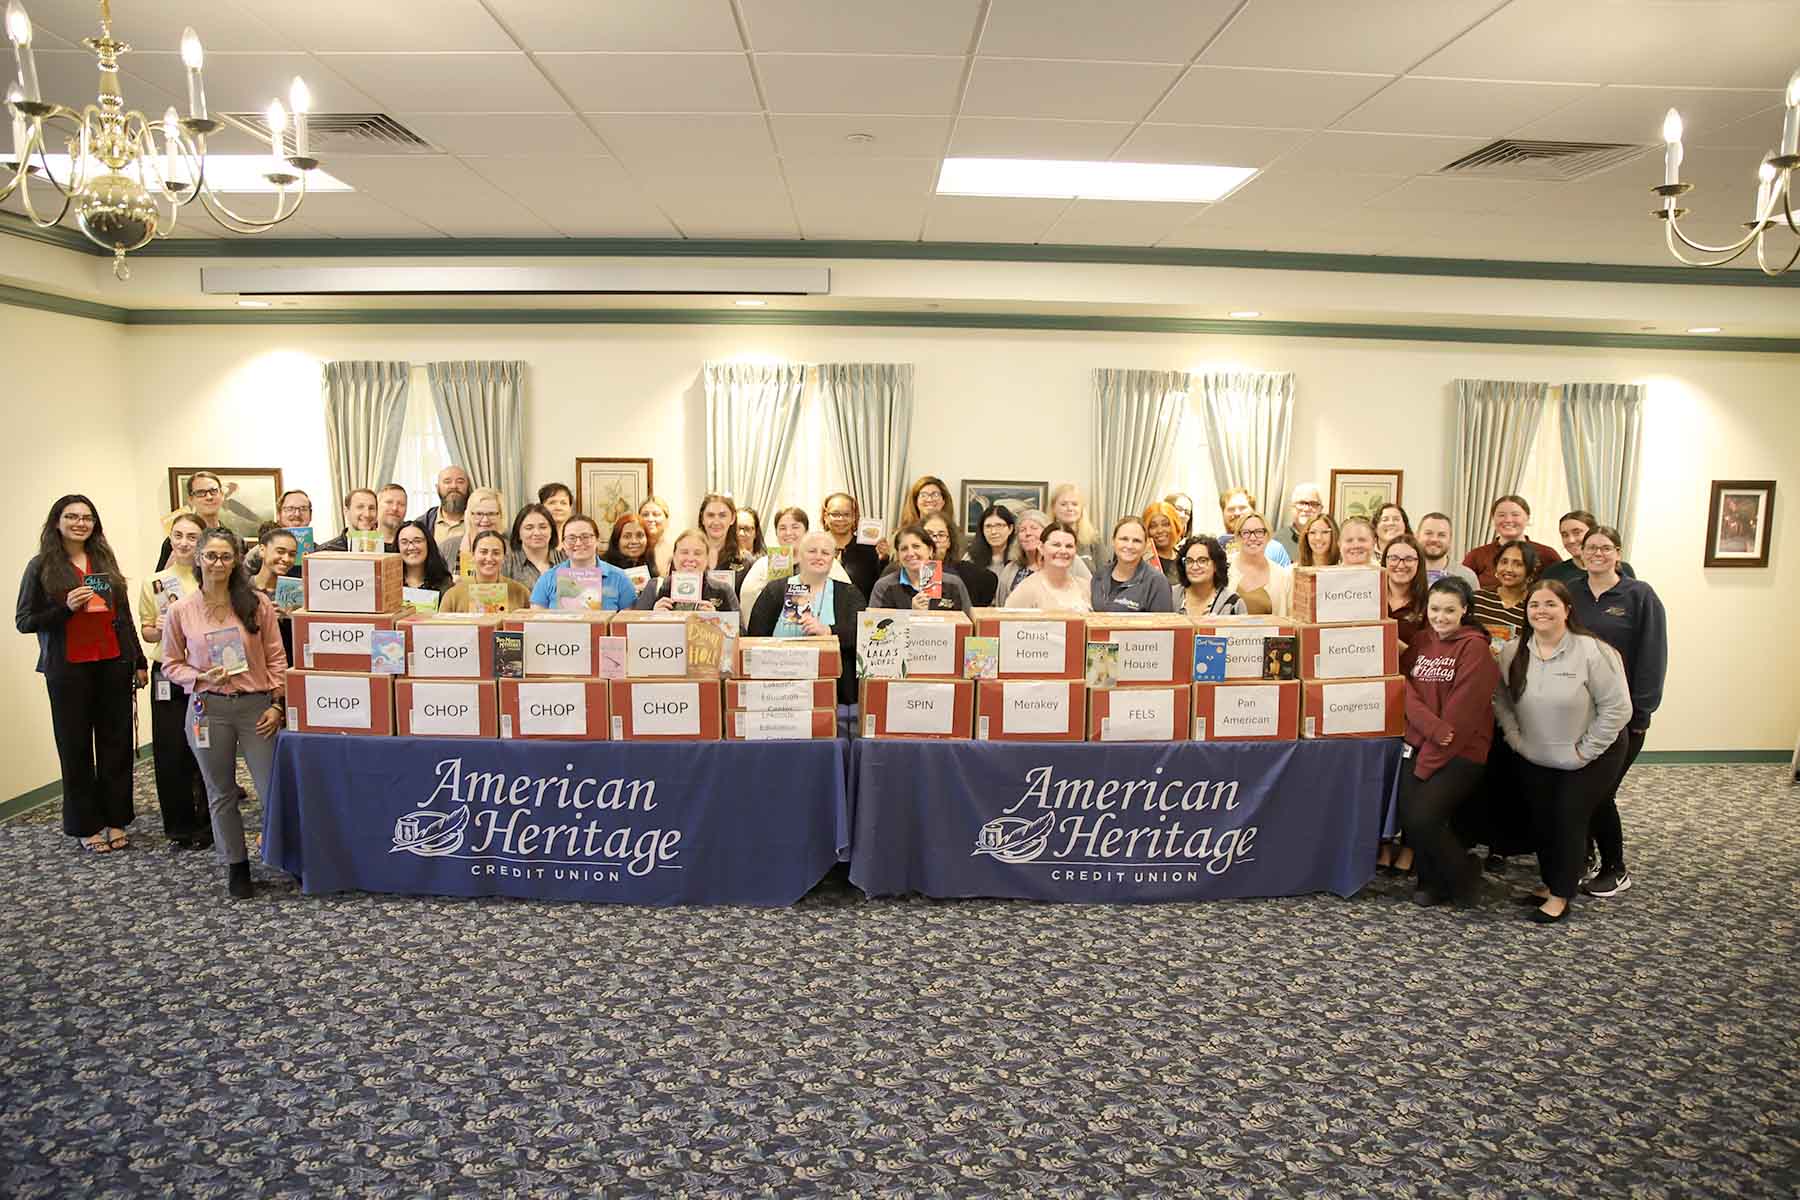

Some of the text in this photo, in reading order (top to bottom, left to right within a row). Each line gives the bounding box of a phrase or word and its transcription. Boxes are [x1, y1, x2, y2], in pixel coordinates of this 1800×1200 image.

[319, 578, 365, 592] CHOP
[1324, 590, 1372, 601] KenCrest
[319, 629, 365, 643] CHOP
[1016, 630, 1049, 641] Christ
[907, 639, 948, 648] vidence
[1125, 642, 1158, 652] Laurel
[1227, 637, 1264, 647] Gemm
[423, 646, 469, 660] CHOP
[535, 643, 581, 656] CHOP
[638, 646, 684, 660] CHOP
[1016, 648, 1049, 659] Home
[1328, 644, 1376, 655] KenCrest
[1123, 659, 1159, 669] House
[1225, 653, 1263, 664] Service
[316, 695, 360, 710] CHOP
[643, 701, 689, 715] CHOP
[906, 699, 934, 710] SPIN
[1014, 699, 1059, 711] Merakey
[1237, 698, 1256, 709] Pan
[1329, 702, 1380, 713] Congresso
[423, 703, 469, 717] CHOP
[529, 703, 575, 717] CHOP
[1129, 709, 1156, 720] FELS
[1223, 715, 1270, 725] American
[417, 758, 658, 812] American
[1002, 765, 1240, 814] American
[471, 808, 682, 877] Heritage
[1053, 812, 1258, 876] Heritage
[471, 864, 621, 882] CREDIT UNION
[1051, 869, 1198, 883] CREDIT UNION
